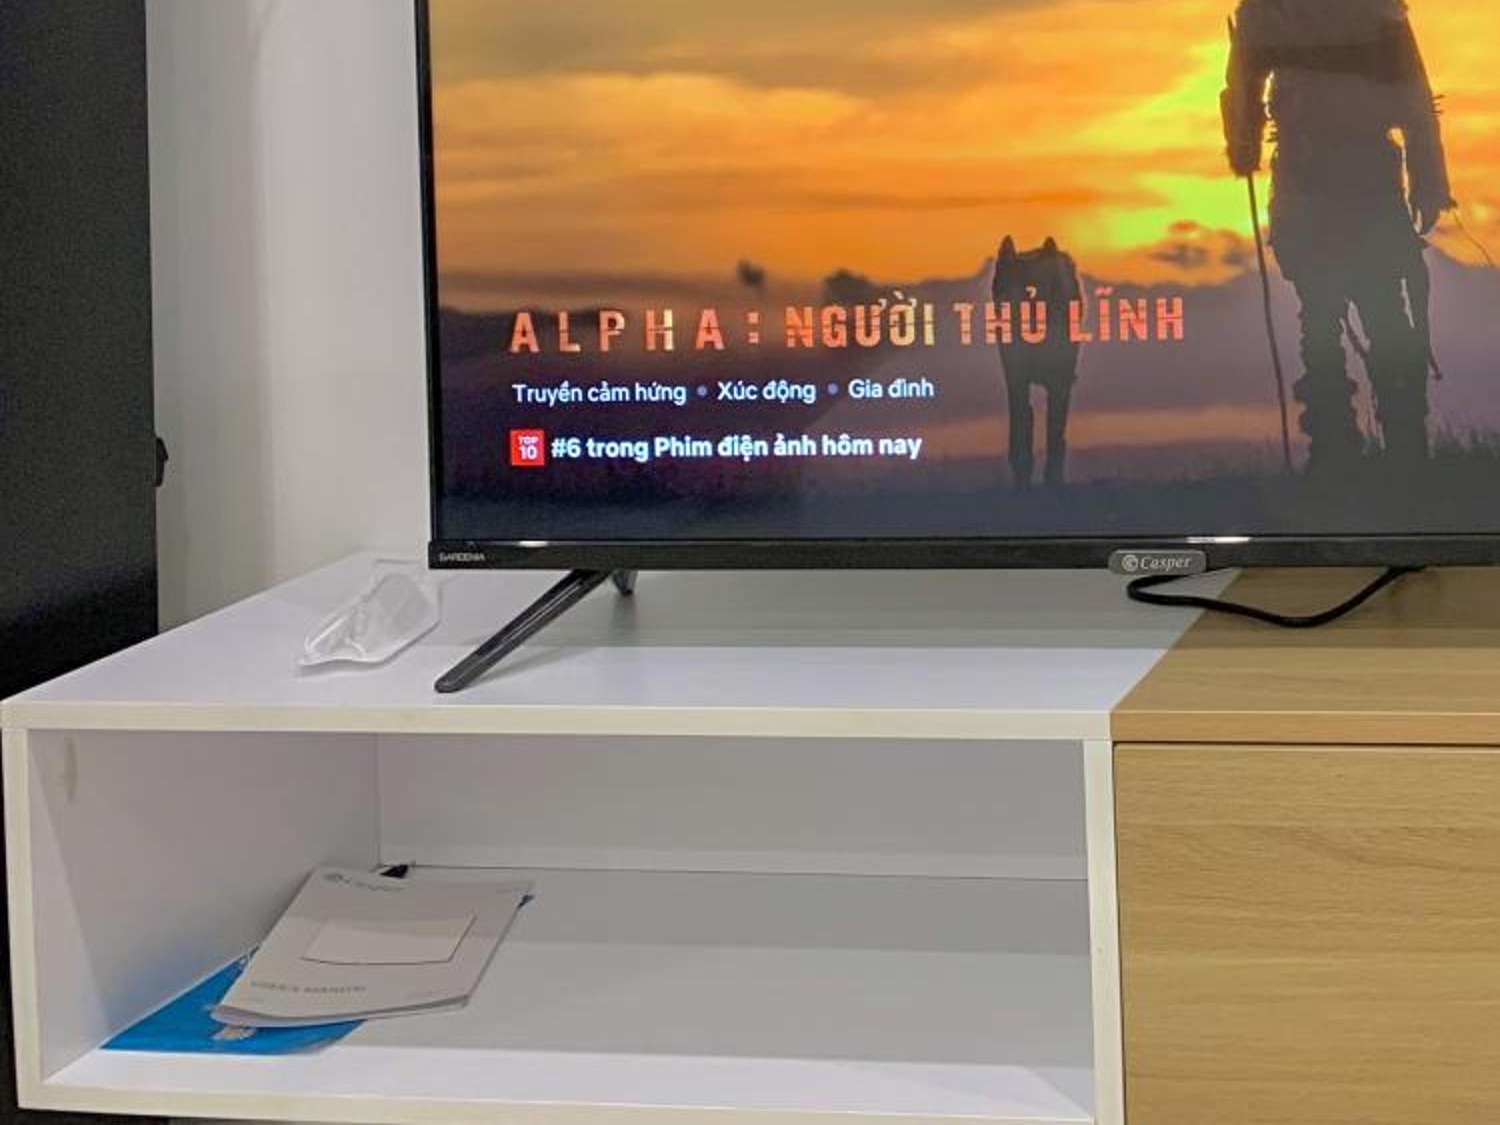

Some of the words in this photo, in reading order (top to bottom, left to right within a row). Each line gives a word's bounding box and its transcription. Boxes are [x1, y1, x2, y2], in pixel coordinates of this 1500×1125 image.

[953, 286, 1047, 346] THỦ
[512, 380, 583, 407] Truyền
[587, 381, 630, 402] cảm
[635, 381, 687, 406] hứng
[717, 380, 758, 400] Xúc
[762, 380, 817, 404] động
[848, 379, 883, 398] Gia
[888, 377, 935, 398] đình
[518, 436, 539, 445] TOP
[552, 437, 582, 459] #6
[586, 437, 649, 463] trong
[654, 435, 713, 457] Phim
[717, 434, 769, 462] điện
[773, 433, 817, 457] ảnh
[821, 433, 874, 456] hôm
[879, 437, 923, 460] nay
[519, 445, 538, 460] 10
[1140, 555, 1193, 572] Casper
